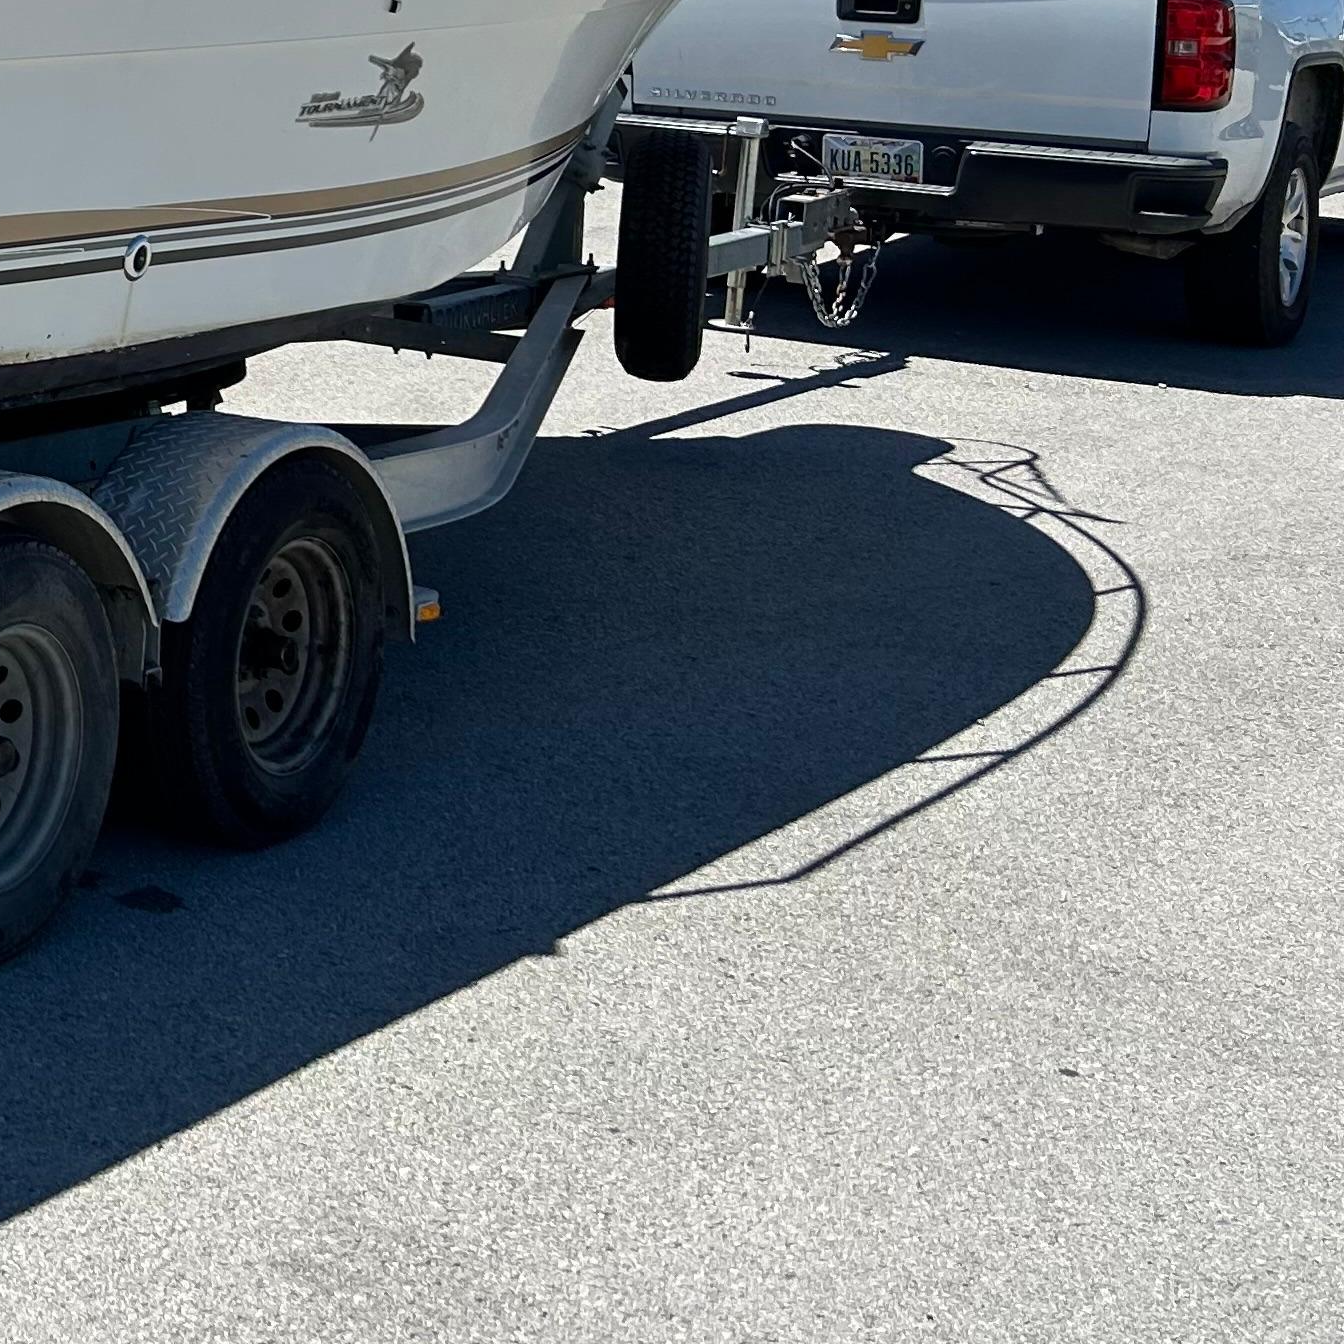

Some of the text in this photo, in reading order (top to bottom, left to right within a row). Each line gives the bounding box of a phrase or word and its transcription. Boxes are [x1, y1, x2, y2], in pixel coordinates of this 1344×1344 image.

[651, 87, 777, 106] SILVERADO
[829, 148, 914, 176] KUA 5336
